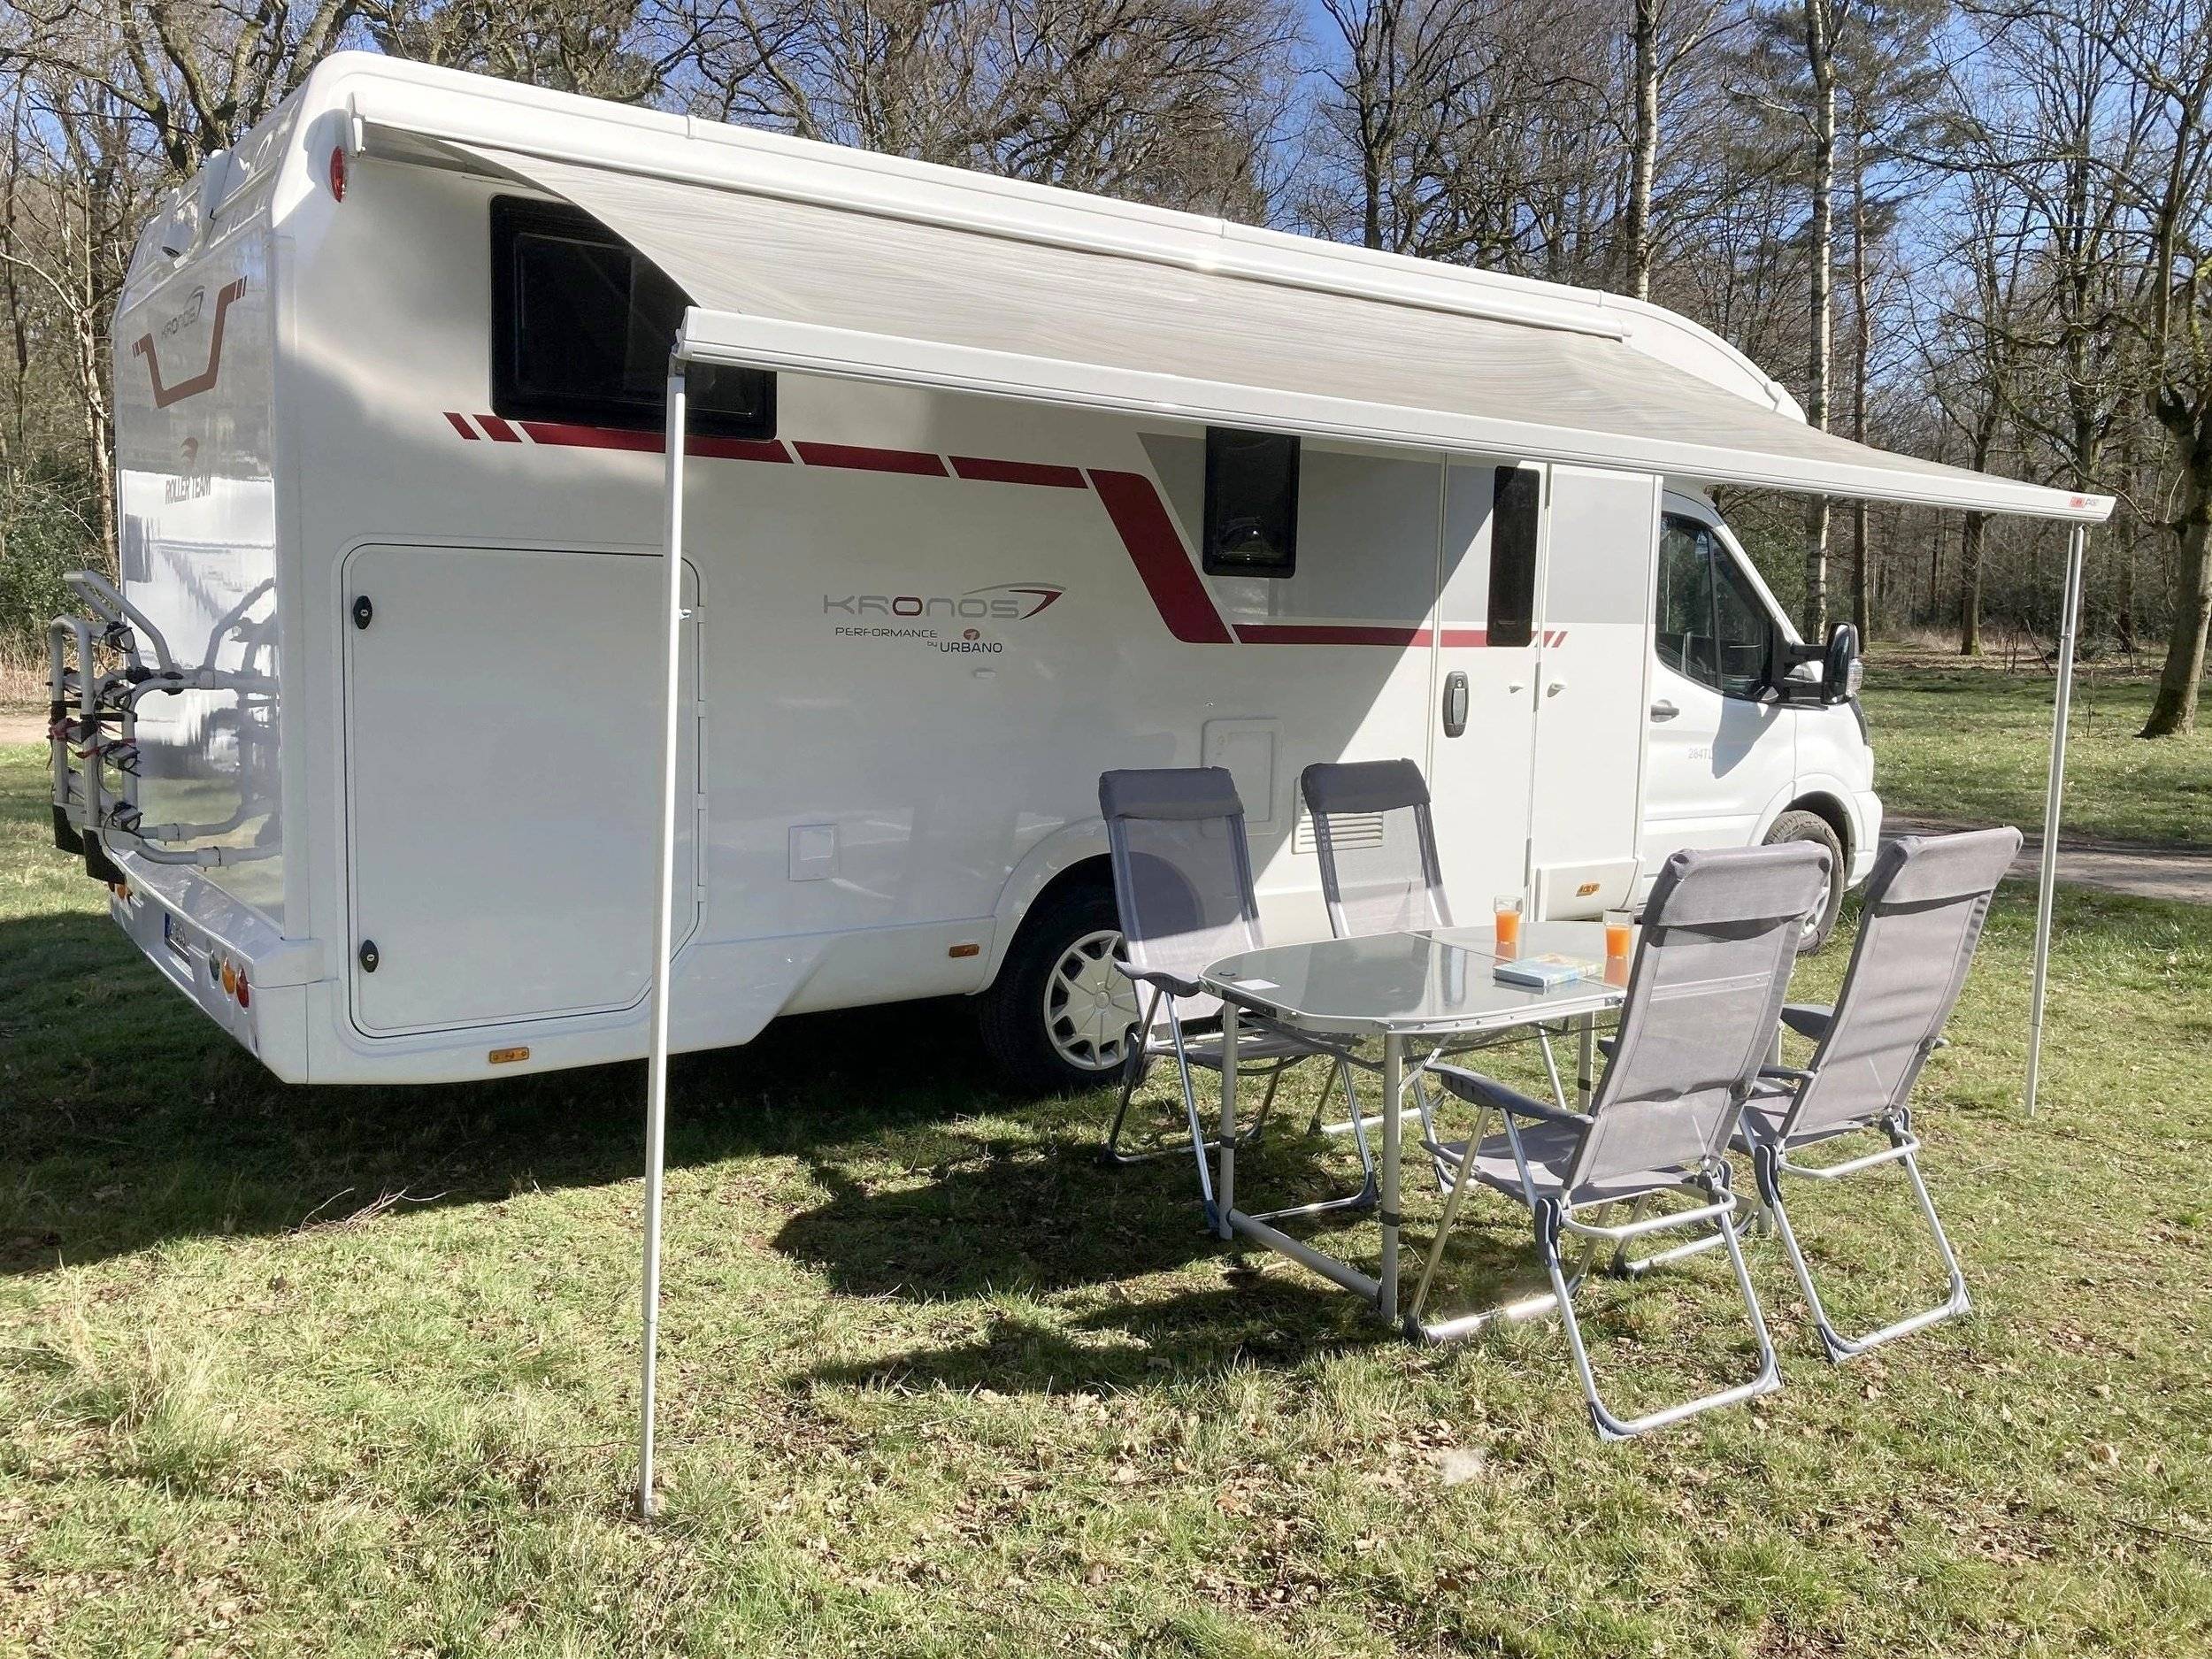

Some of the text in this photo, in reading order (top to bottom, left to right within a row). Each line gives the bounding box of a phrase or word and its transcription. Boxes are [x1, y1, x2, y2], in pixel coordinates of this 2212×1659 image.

[165, 472, 211, 505] ROLLER TEAM
[835, 626, 938, 639] PERFORMANCE
[940, 641, 1003, 653] URBANO
